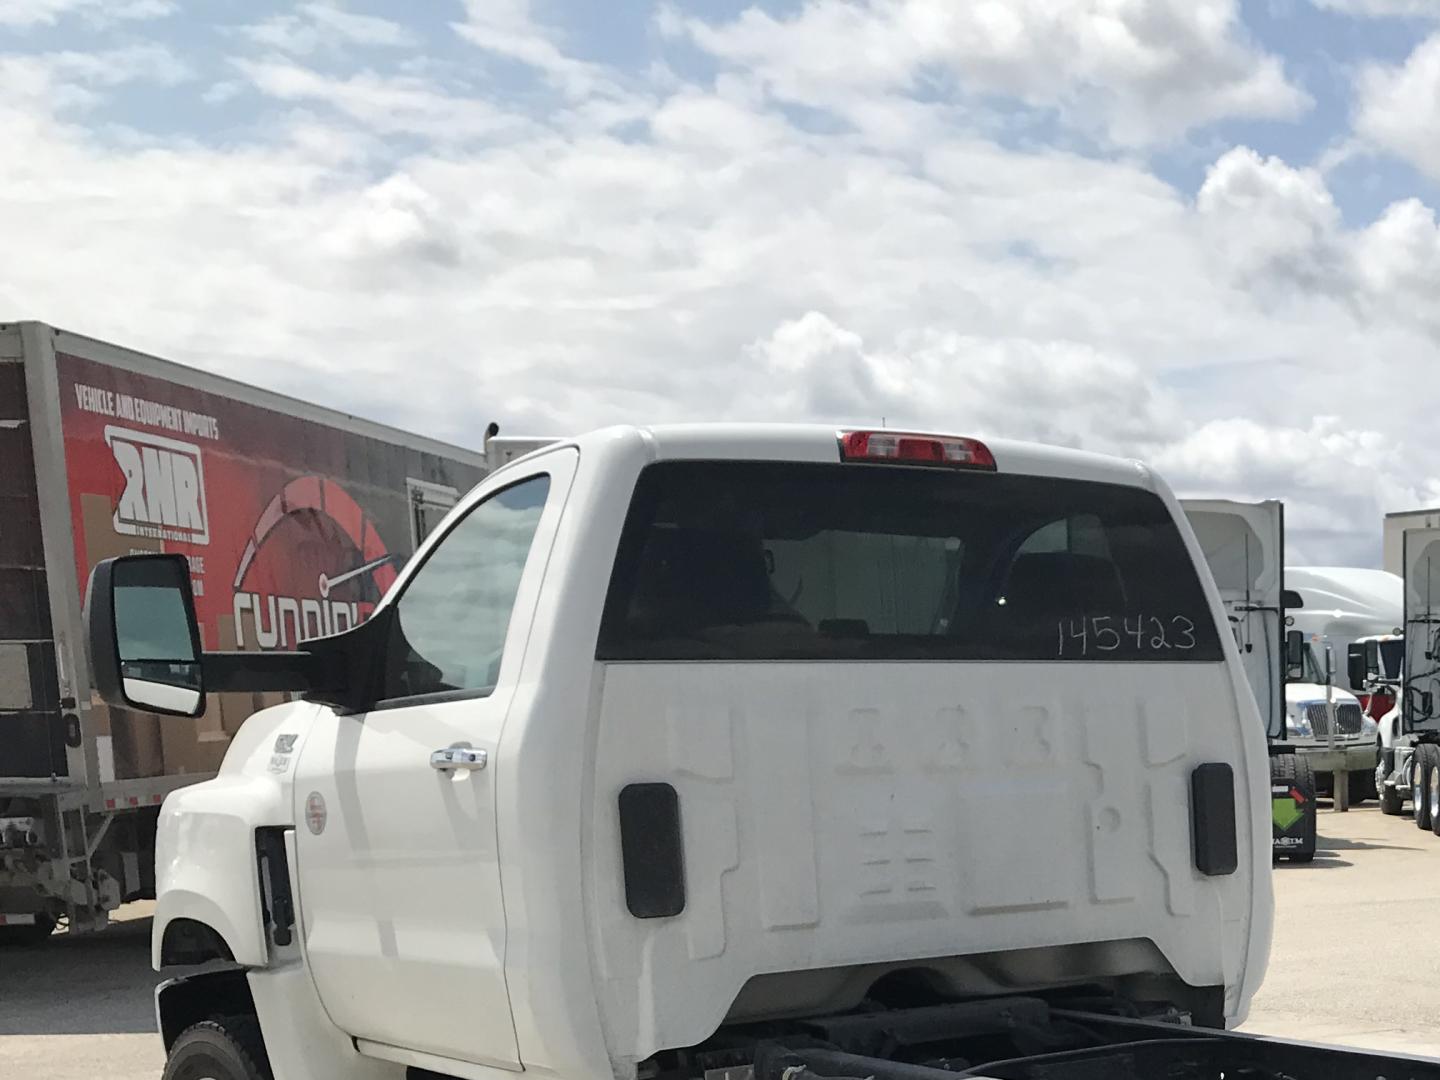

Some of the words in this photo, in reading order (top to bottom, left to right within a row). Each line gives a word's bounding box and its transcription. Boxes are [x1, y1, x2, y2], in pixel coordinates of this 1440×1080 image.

[74, 383, 115, 416] VEHICLE
[115, 393, 134, 420] AND
[134, 397, 183, 432] EQUIPMENT
[182, 410, 219, 440] IMPORTS
[1058, 614, 1196, 655] 145423
